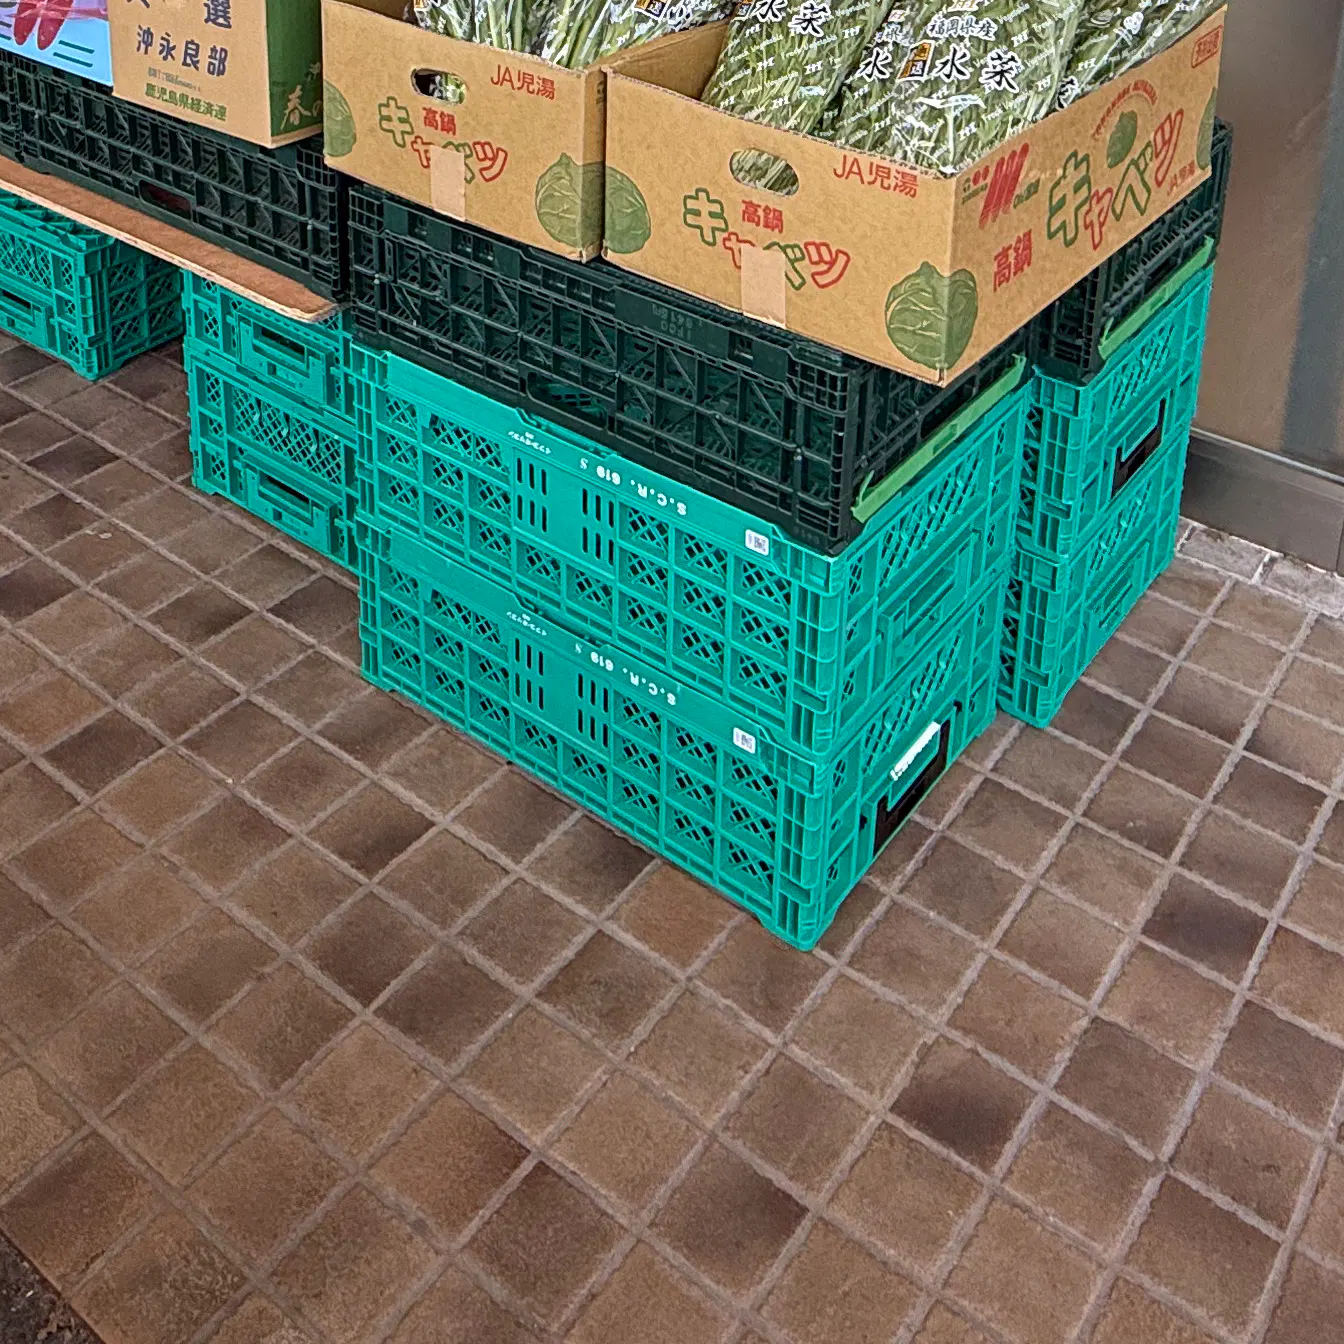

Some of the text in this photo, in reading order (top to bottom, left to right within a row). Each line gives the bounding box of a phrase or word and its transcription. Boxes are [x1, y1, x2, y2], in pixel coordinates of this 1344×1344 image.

[927, 17, 998, 41] 福岡県産
[136, 24, 229, 77] 沖永良部
[856, 48, 892, 82] 水
[932, 44, 1020, 93] 水菜
[144, 82, 228, 122] 鹿児島県経済連
[490, 63, 556, 101] JA児湯
[422, 107, 457, 136] 高鍋
[833, 155, 919, 199] JA児湯
[1047, 108, 1184, 251] キャベツ
[741, 199, 784, 234] 高鍋
[992, 229, 1033, 293] 高鍋
